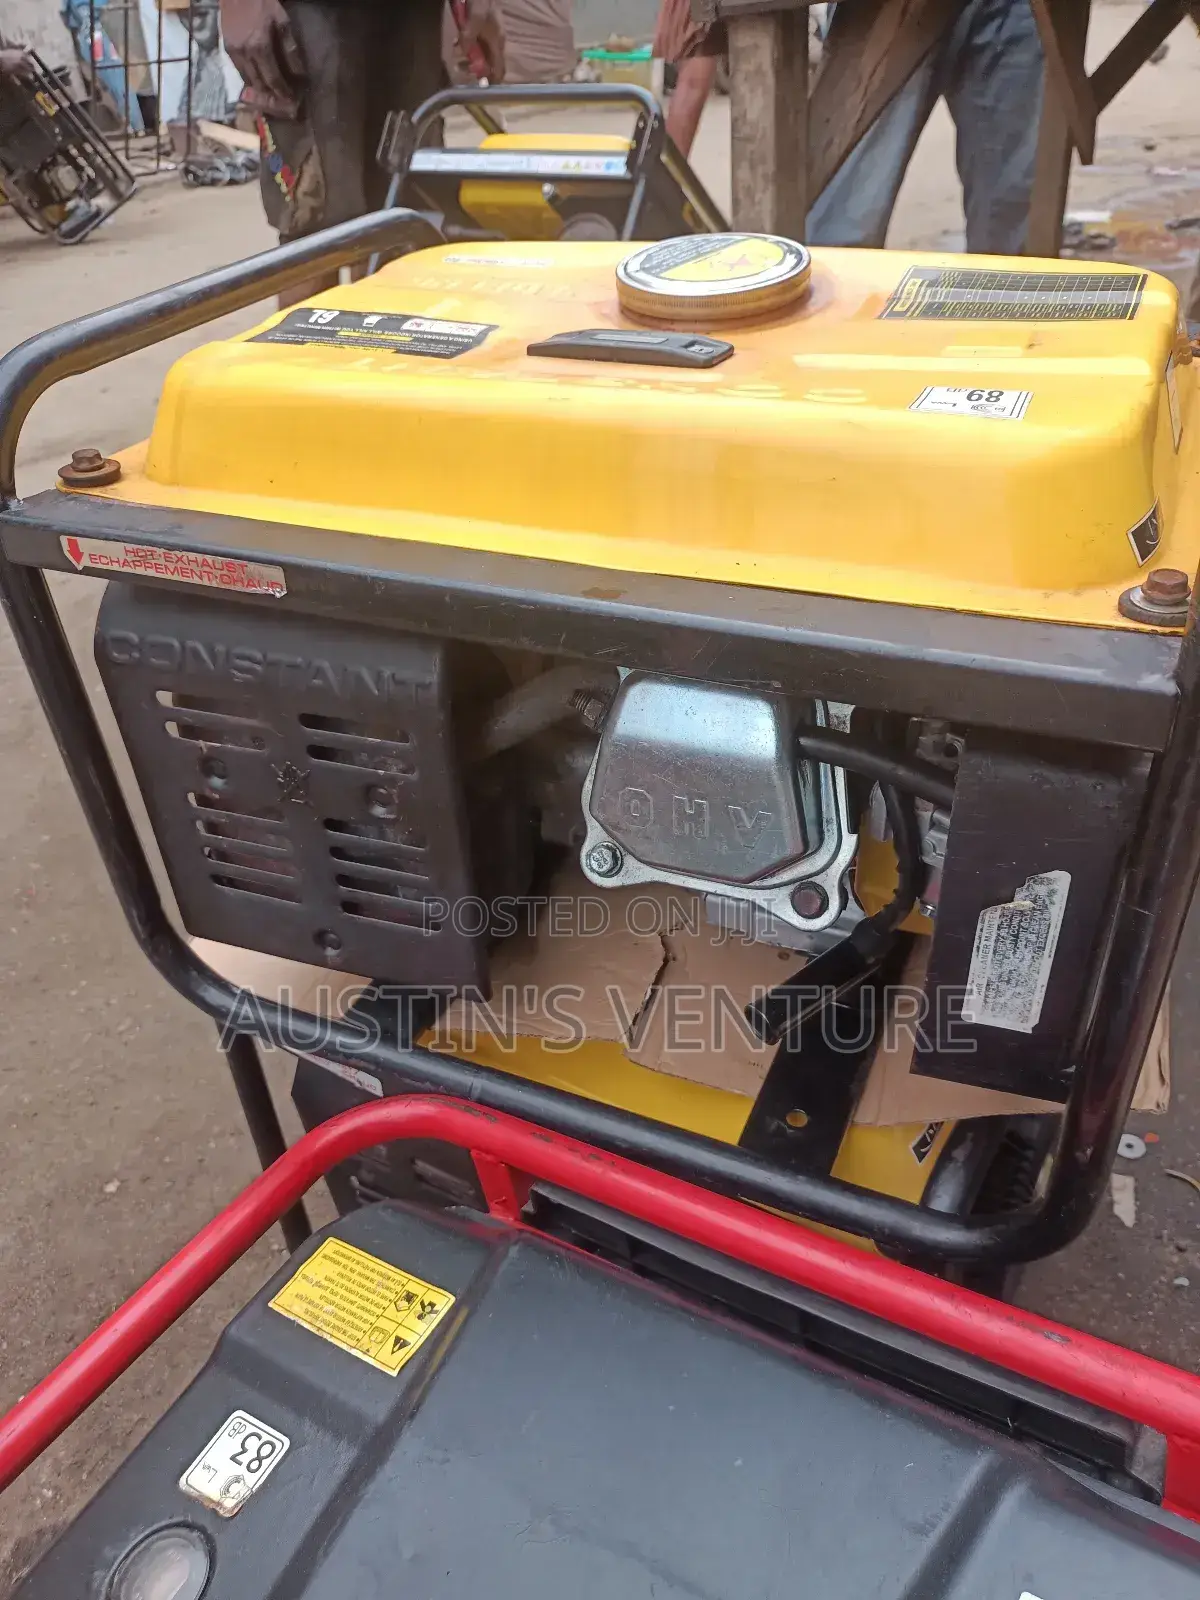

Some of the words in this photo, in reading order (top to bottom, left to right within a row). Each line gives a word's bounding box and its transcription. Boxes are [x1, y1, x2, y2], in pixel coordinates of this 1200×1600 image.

[966, 389, 1004, 403] 89
[88, 553, 214, 581] ECHAPPEMENT
[163, 552, 248, 575] EXHAUST
[105, 629, 437, 702] CONSTANT
[618, 787, 772, 849] OHV
[227, 1421, 247, 1440] dB
[229, 1431, 277, 1474] 83
